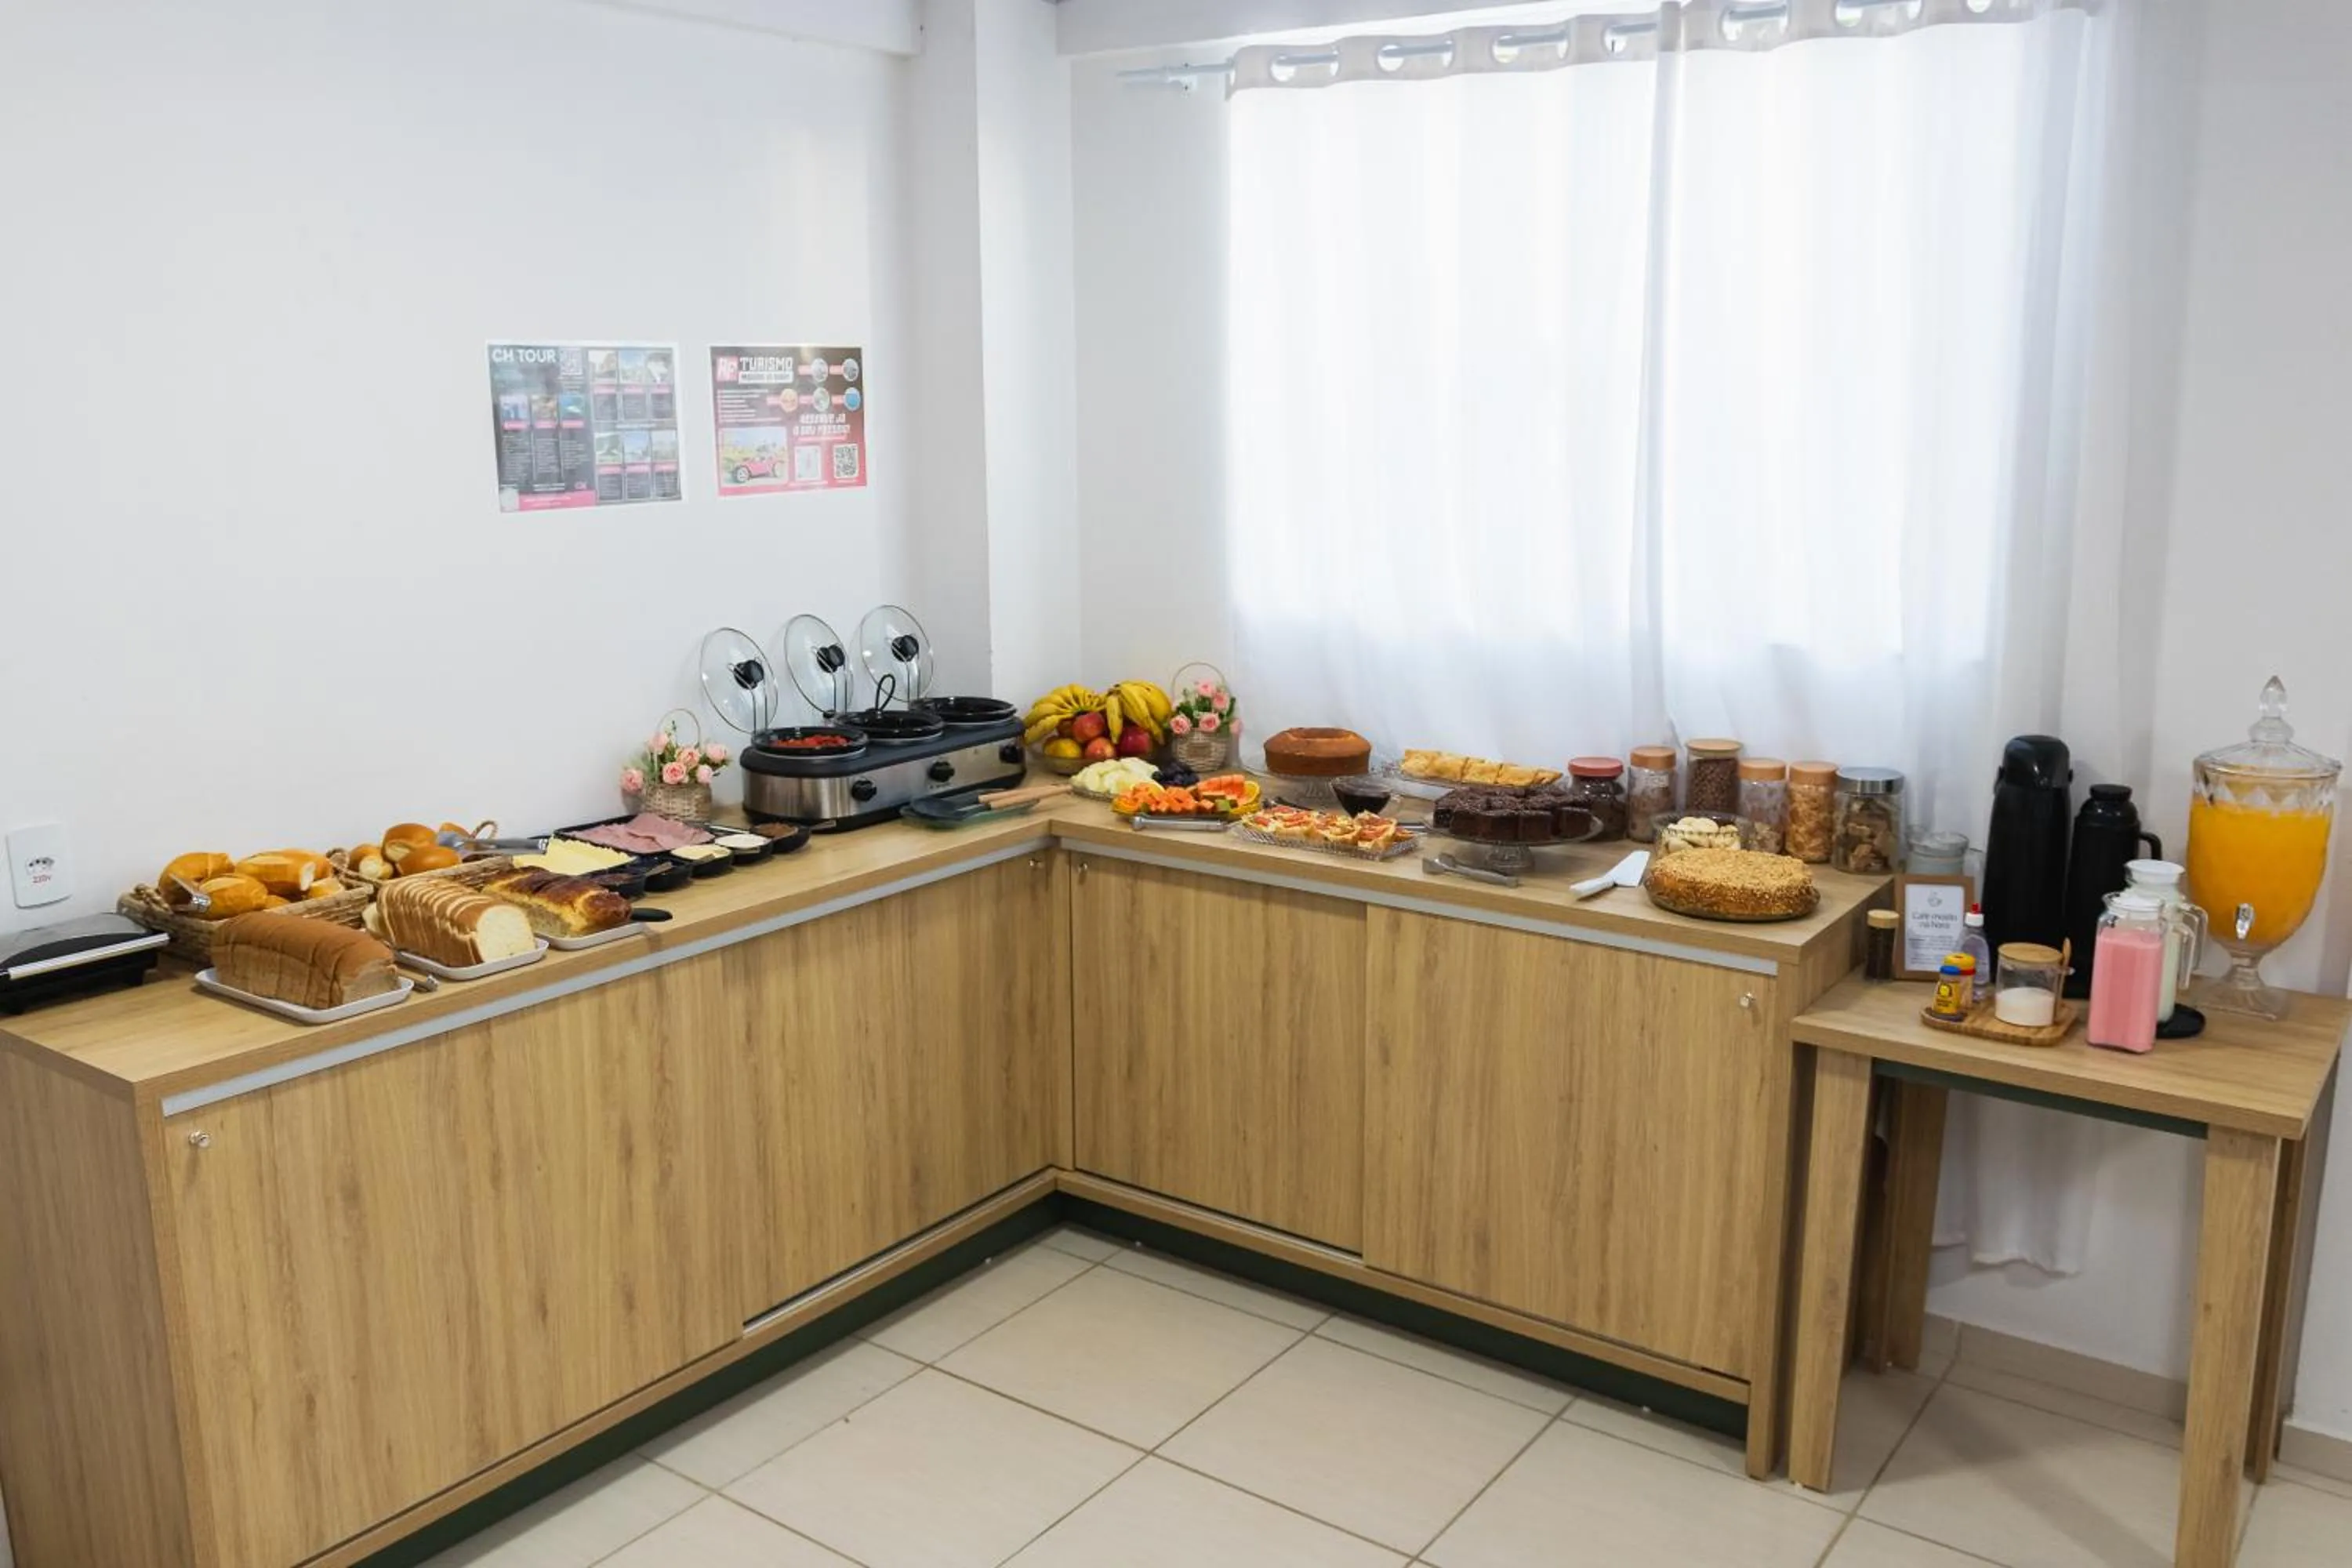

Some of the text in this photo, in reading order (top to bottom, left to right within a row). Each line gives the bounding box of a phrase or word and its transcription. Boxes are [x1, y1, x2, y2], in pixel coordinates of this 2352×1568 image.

[492, 348, 556, 363] CH TOUR
[740, 357, 793, 371] TURISMO
